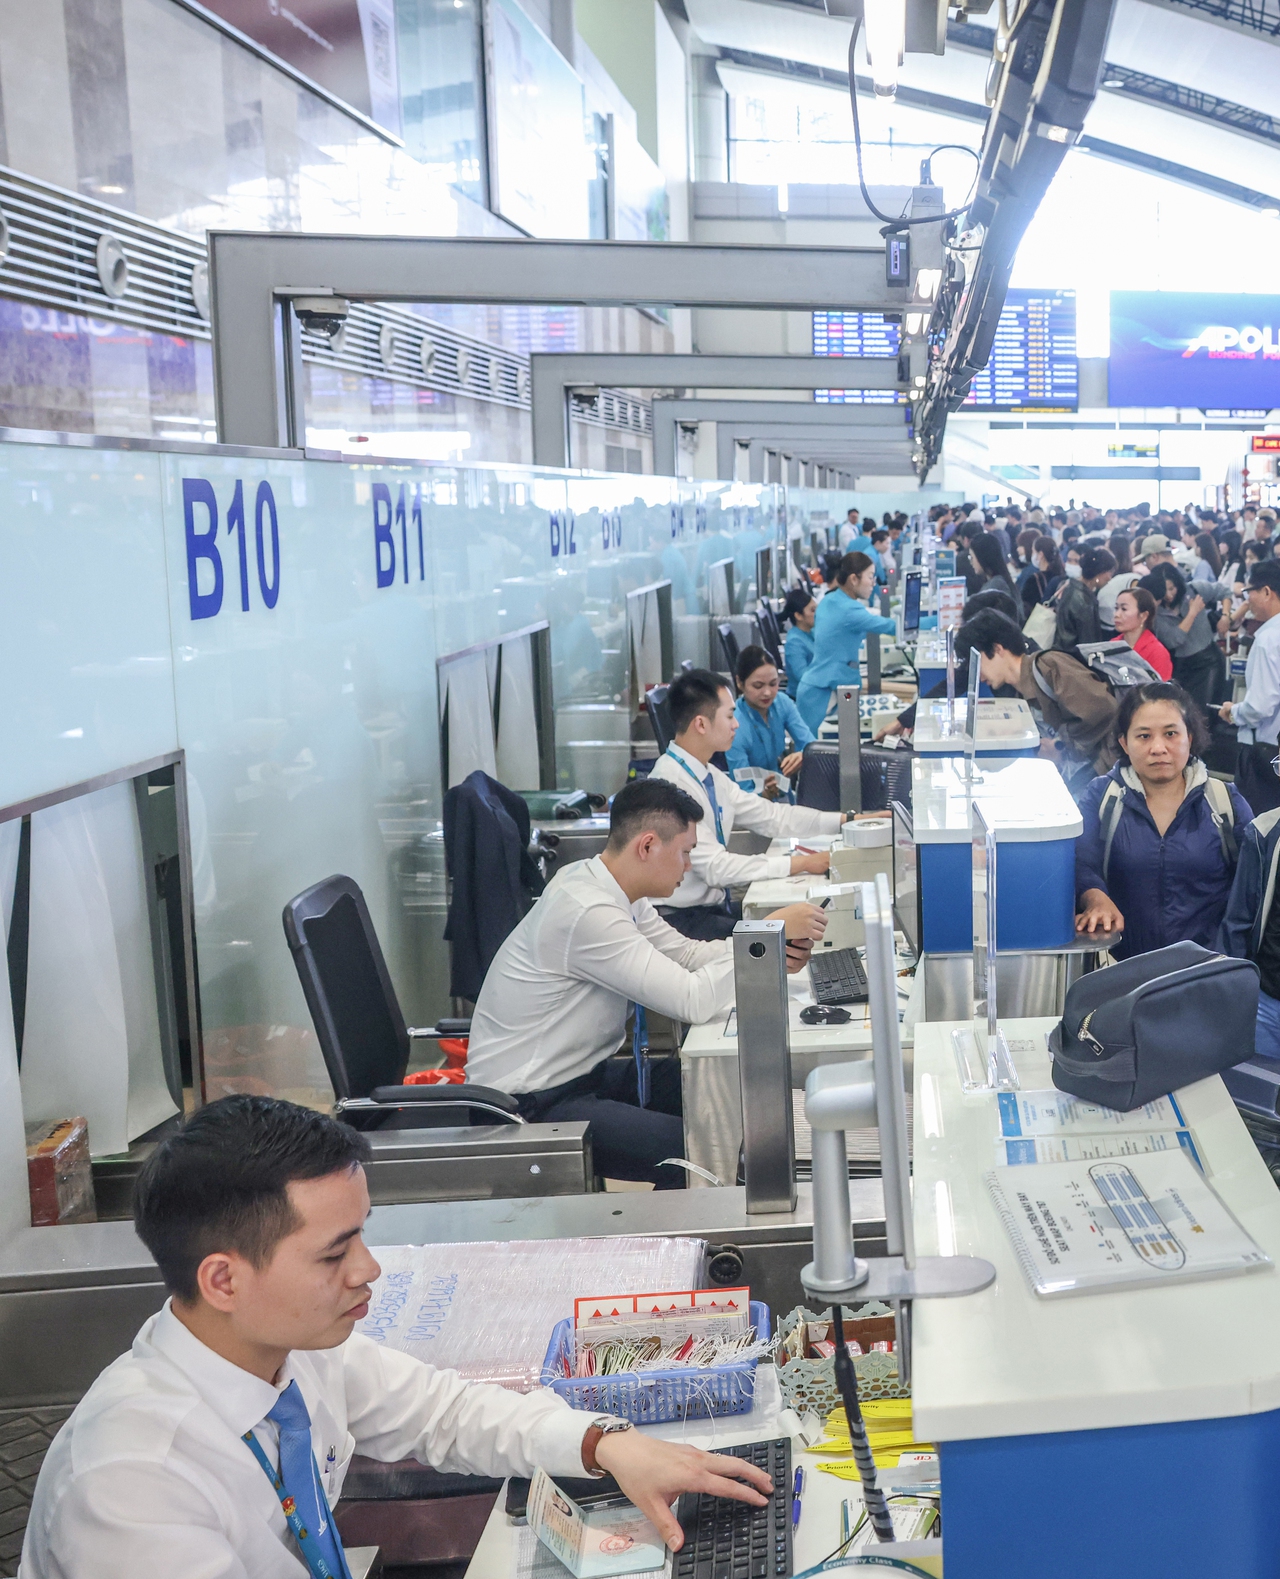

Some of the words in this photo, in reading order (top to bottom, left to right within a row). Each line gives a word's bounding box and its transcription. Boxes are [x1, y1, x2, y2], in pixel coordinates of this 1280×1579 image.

[372, 483, 424, 588] B11
[182, 478, 280, 620] B10
[1016, 1191, 1028, 1202] BAY
[1040, 1209, 1057, 1227] BOEING
[317, 1559, 330, 1578] VIAGS
[822, 1557, 868, 1571] Economy
[868, 1556, 893, 1566] Class
